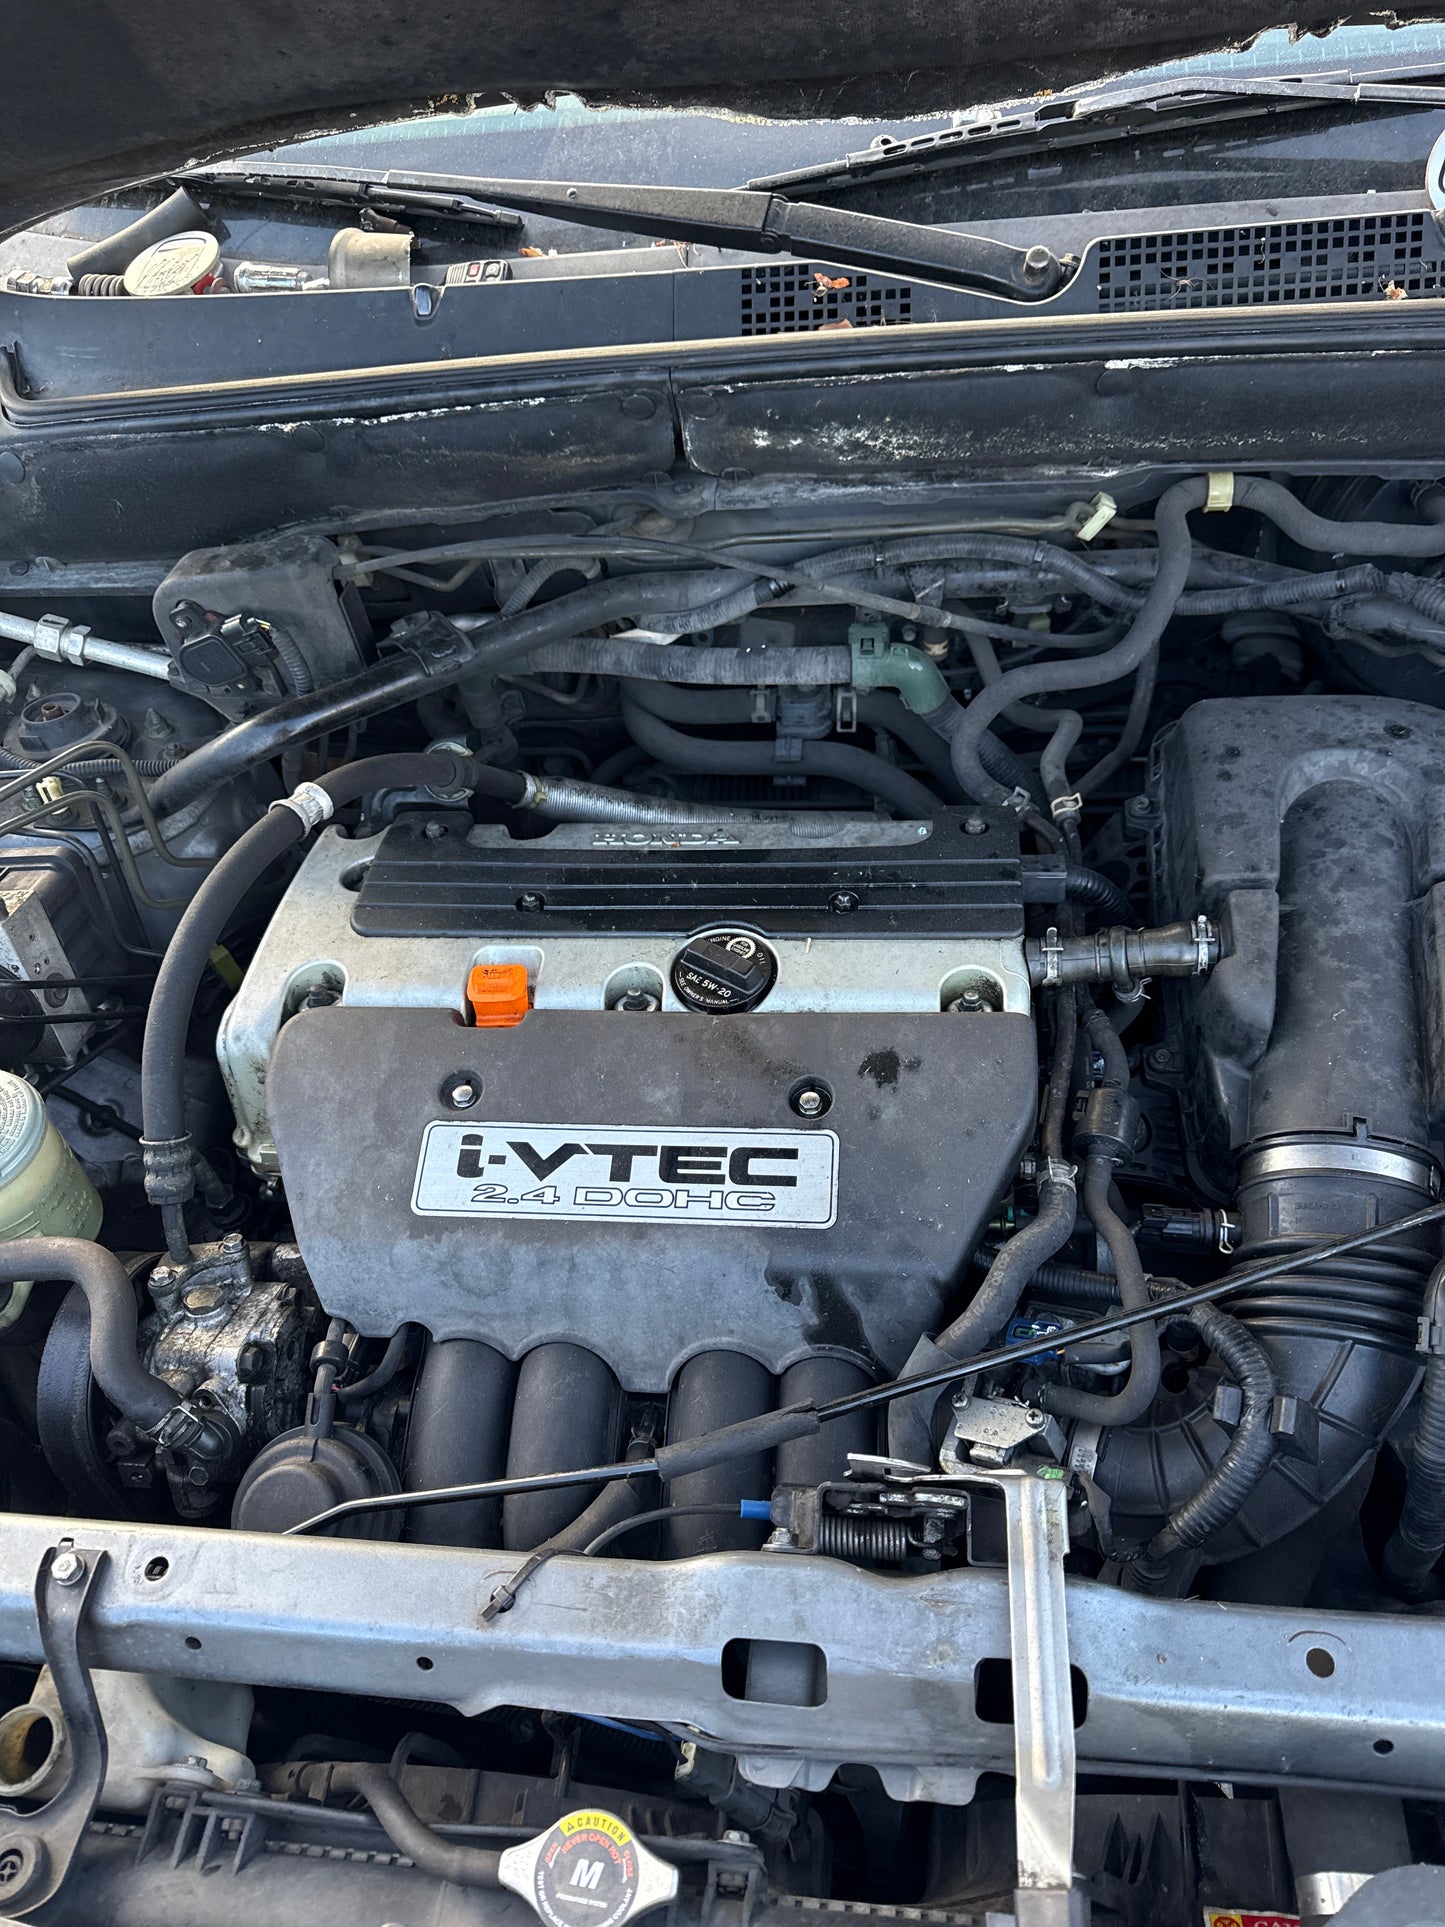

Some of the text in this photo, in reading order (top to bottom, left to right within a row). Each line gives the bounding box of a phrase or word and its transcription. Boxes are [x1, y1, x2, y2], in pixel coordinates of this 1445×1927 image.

[592, 833, 741, 846] HONDA
[756, 952, 766, 965] OIL
[686, 972, 732, 998] SAE 5W-20
[456, 1133, 799, 1188] i-VTEC
[471, 1184, 776, 1212] 2.4 DOHC
[577, 1817, 625, 1841] CAUTION
[561, 1833, 621, 1865] NEVER OPEN HOT
[569, 1858, 606, 1890] M
